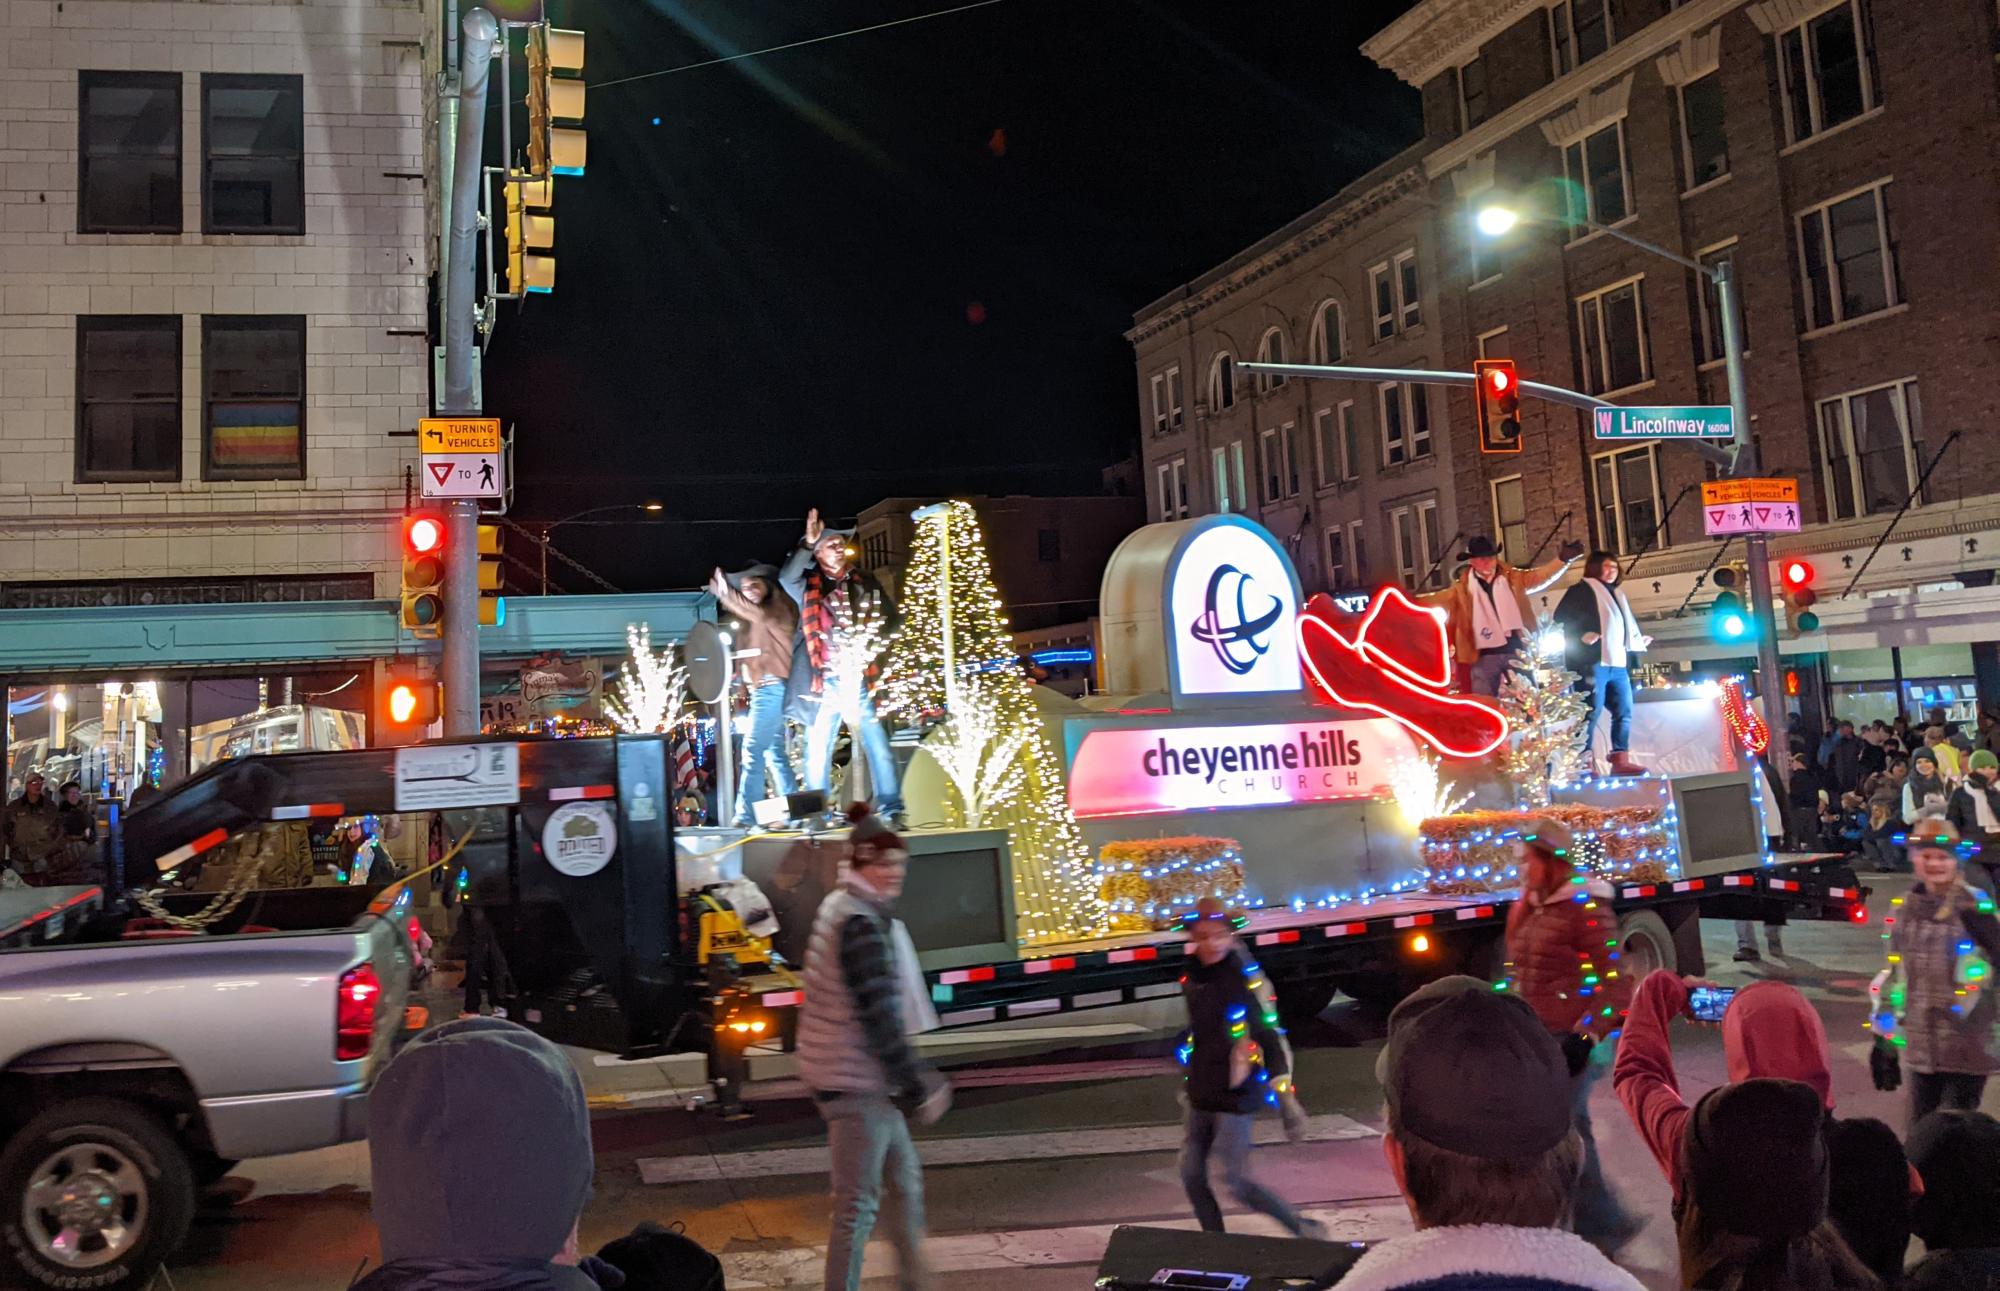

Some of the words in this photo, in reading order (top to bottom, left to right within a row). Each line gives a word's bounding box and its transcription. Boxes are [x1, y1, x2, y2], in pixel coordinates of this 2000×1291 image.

[1598, 411, 1612, 434] W
[1620, 411, 1705, 436] Lincolnway
[448, 424, 494, 434] TURNING
[447, 438, 496, 448] VEHICLES
[458, 470, 472, 479] TO
[1720, 482, 1748, 491] TURNING
[1720, 491, 1750, 500] VEHICLES
[1727, 513, 1737, 521] TO
[1218, 771, 1358, 794] CHURCH
